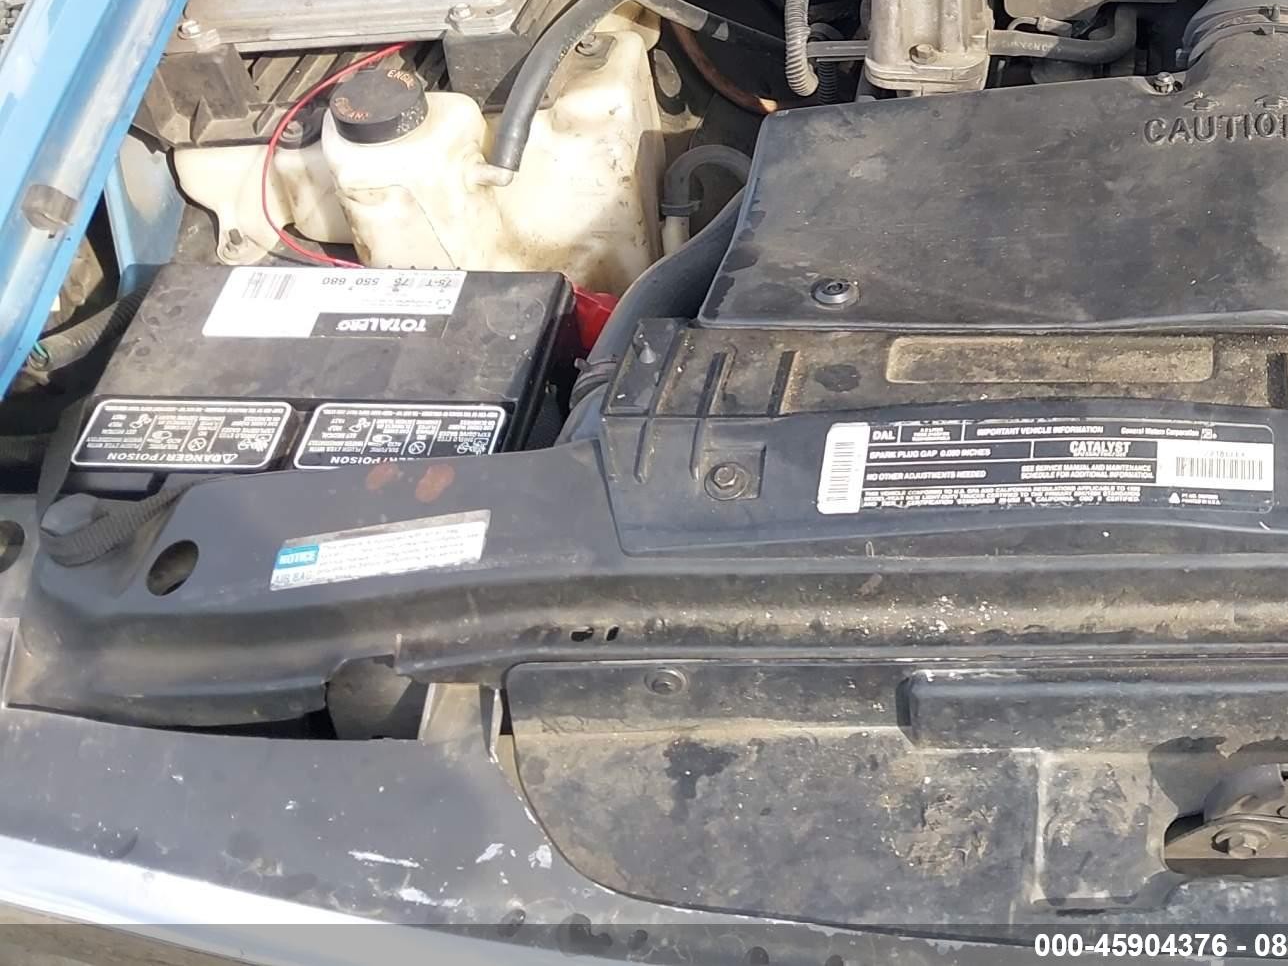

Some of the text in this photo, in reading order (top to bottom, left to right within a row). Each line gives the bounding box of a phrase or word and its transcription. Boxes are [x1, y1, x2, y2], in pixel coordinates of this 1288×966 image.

[336, 317, 427, 332] TOTALPRO
[872, 430, 896, 441] DAL
[1020, 426, 1052, 434] VEHICLE
[1070, 440, 1131, 453] CATALYST
[106, 452, 223, 463] DANGER/POISON
[898, 450, 919, 458] PLUG
[920, 449, 938, 457] GAP
[961, 448, 991, 456] INCHES
